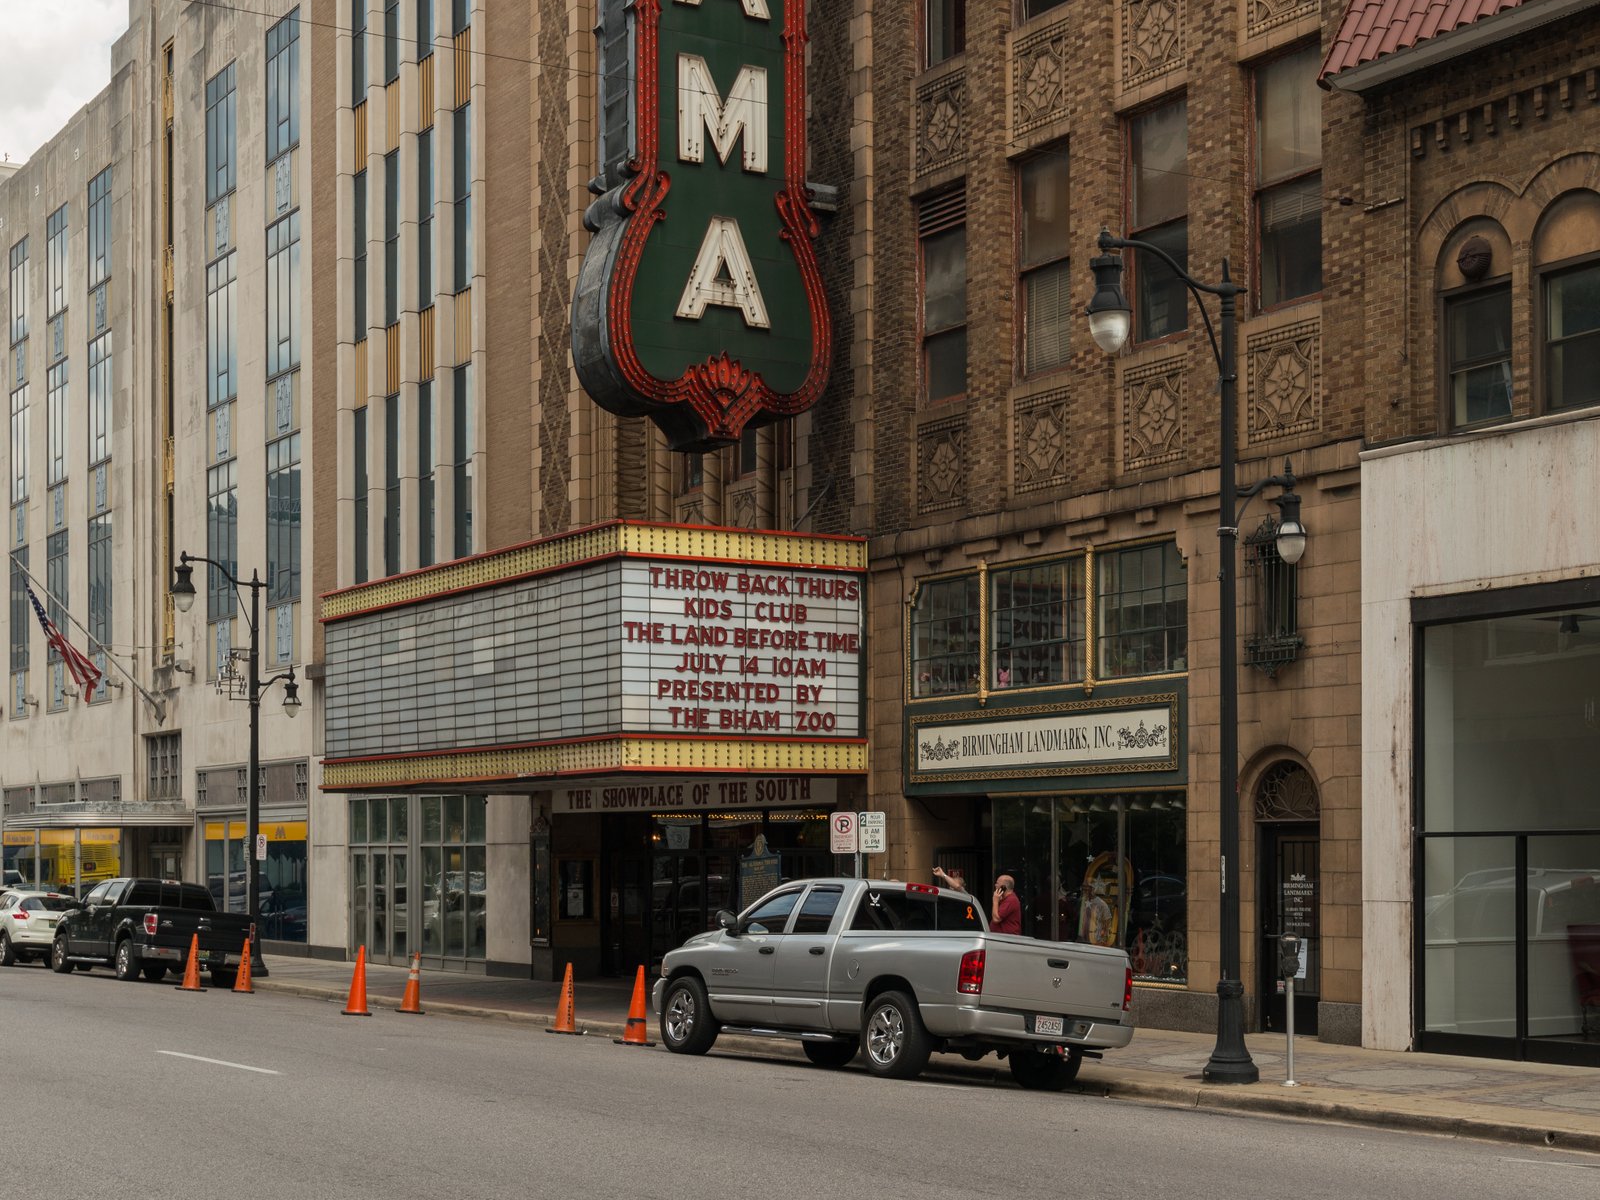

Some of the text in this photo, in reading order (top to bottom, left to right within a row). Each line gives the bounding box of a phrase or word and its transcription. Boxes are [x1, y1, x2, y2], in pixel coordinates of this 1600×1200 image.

[649, 566, 859, 601] THROW BACK THURS
[684, 596, 808, 624] KIDS CLUB
[623, 621, 860, 654] THE LAND BEFORE TIME
[674, 652, 727, 674] JULY
[739, 654, 758, 676] 14
[657, 678, 823, 705] PRESENTED BY
[668, 706, 836, 732] THE BHAM ZOO
[962, 724, 1115, 757] BIRMINGHAM LANDMARKS, INC.
[567, 777, 812, 810] THE SHOWPLACE OF THE SOUTH
[860, 816, 866, 825] 2
